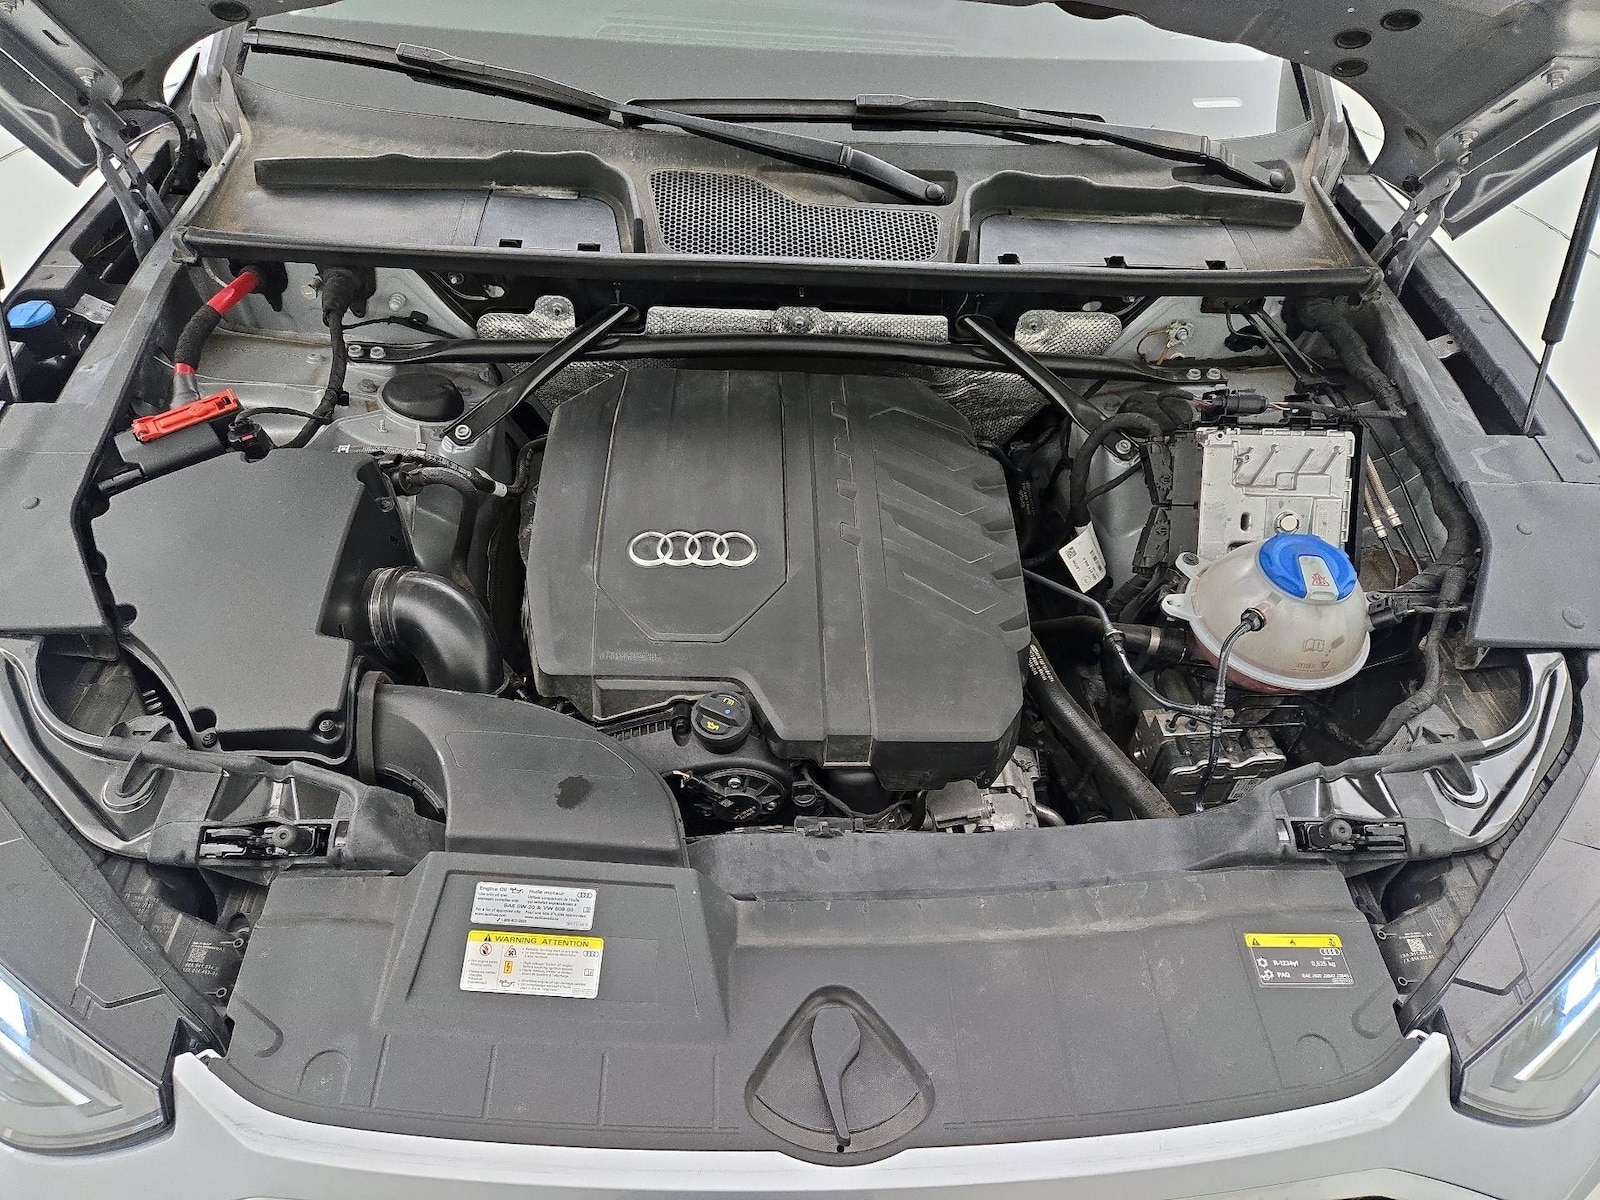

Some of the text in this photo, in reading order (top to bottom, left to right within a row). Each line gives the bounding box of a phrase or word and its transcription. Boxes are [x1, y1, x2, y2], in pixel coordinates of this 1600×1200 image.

[495, 936, 589, 947] WARNING ATTENTION
[1272, 959, 1299, 967] R-1234yf
